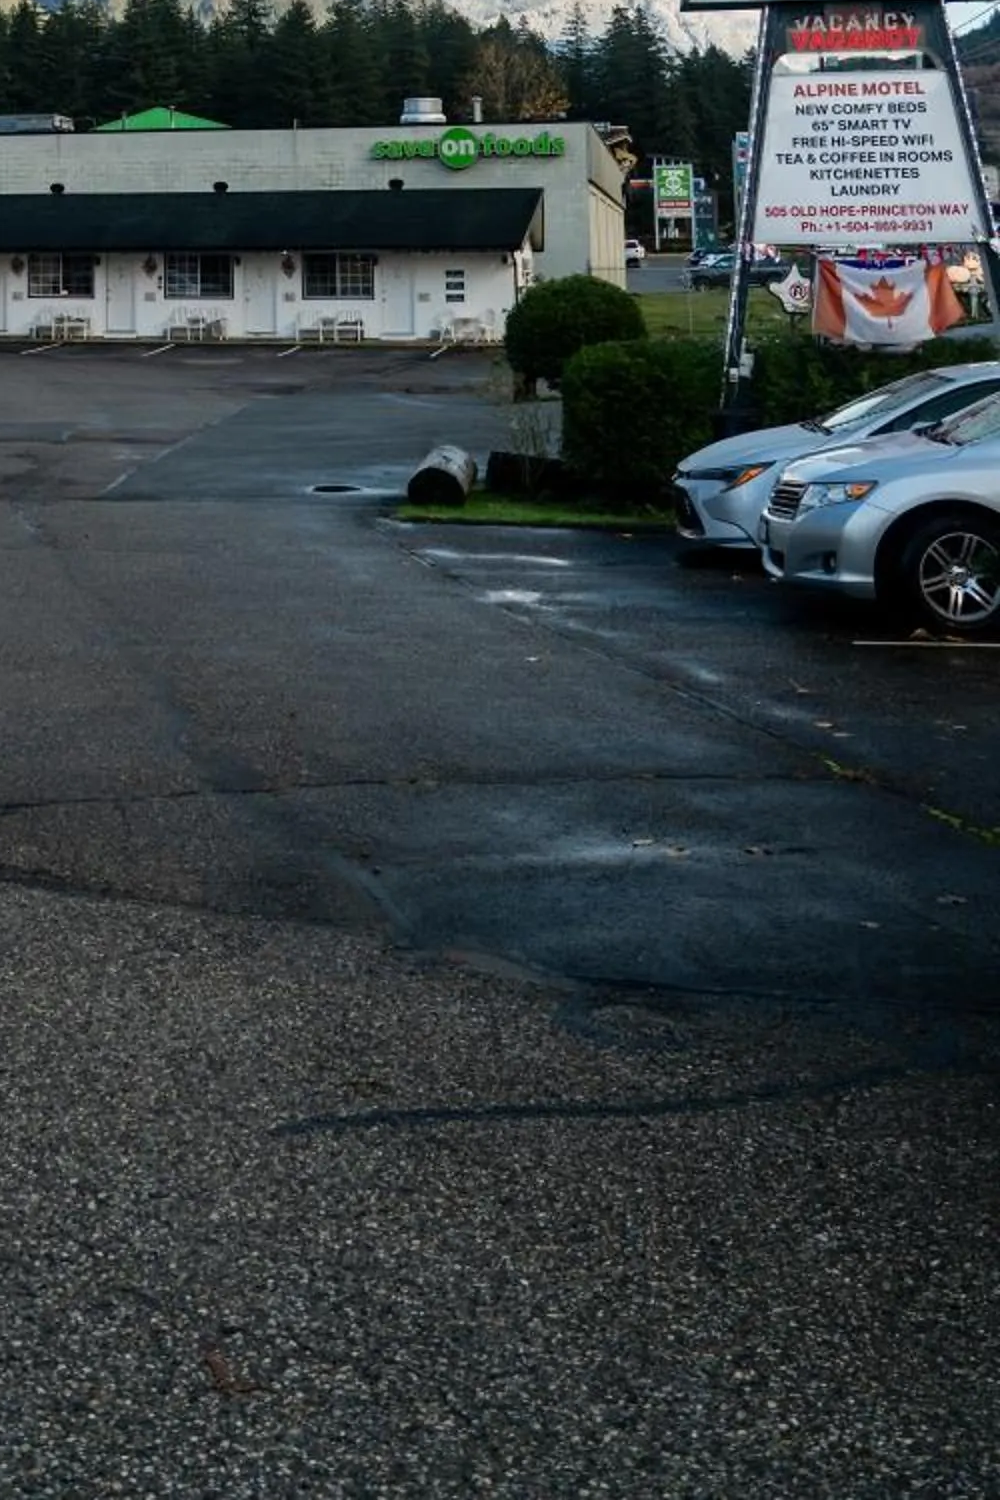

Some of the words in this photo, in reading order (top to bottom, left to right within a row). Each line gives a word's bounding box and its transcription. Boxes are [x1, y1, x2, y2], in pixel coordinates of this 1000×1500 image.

[794, 12, 915, 32] VACANCY
[794, 83, 857, 97] ALPINE
[862, 81, 925, 96] MOTEL
[795, 104, 829, 116] NEW
[832, 102, 883, 115] COMFY
[888, 102, 927, 113] BEDS
[838, 119, 888, 131] SMART
[893, 119, 911, 130] TV
[441, 138, 475, 156] on
[482, 130, 565, 157] foods
[792, 136, 827, 148] FREE
[831, 135, 899, 147] HI-SPEED
[902, 134, 934, 146] WIFI
[776, 153, 805, 165] TEA
[807, 152, 816, 164] &
[820, 152, 877, 164] COFFEE
[880, 151, 894, 162] IN
[898, 150, 953, 162] ROOMS
[810, 167, 920, 181] KITCHENETTES
[831, 184, 901, 196] LAUNDRY
[791, 205, 817, 217] OLD
[820, 203, 935, 217] HOPE-PRINCETON
[939, 203, 969, 216] WAY
